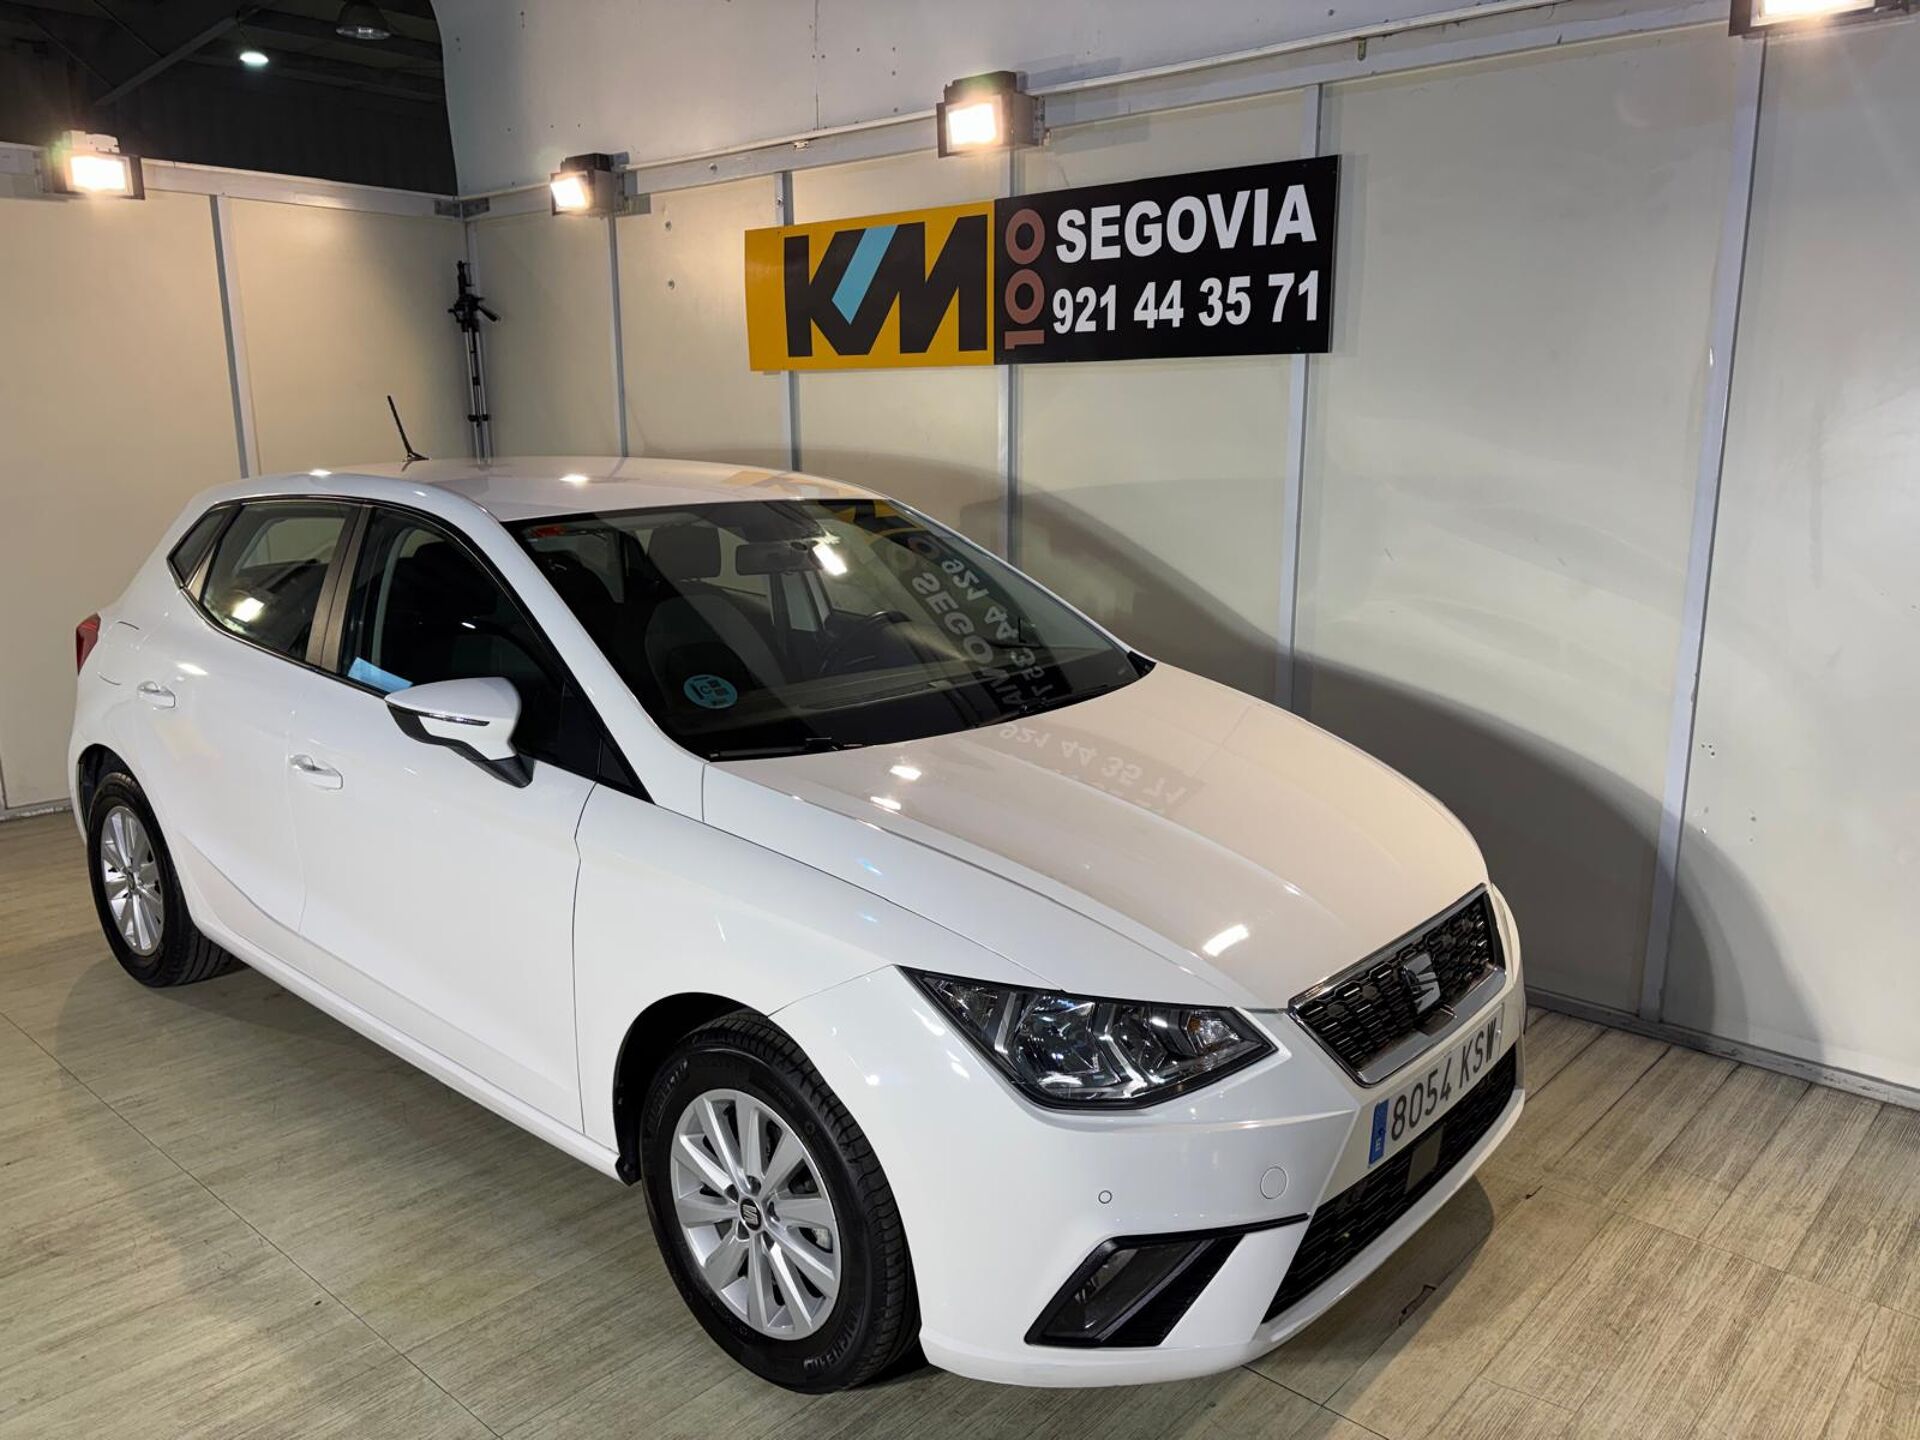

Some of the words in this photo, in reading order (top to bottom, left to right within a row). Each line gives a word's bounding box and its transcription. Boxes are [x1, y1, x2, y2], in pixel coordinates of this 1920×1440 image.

[783, 215, 988, 357] KM
[1004, 208, 1045, 349] 100
[1056, 184, 1317, 263] SEGOVIA
[1052, 284, 1116, 334] 921
[1134, 279, 1184, 329] 44
[1198, 276, 1251, 327] 35
[1268, 270, 1319, 322] 71
[1391, 1057, 1452, 1141] 8054
[1459, 1016, 1497, 1088] KSW
